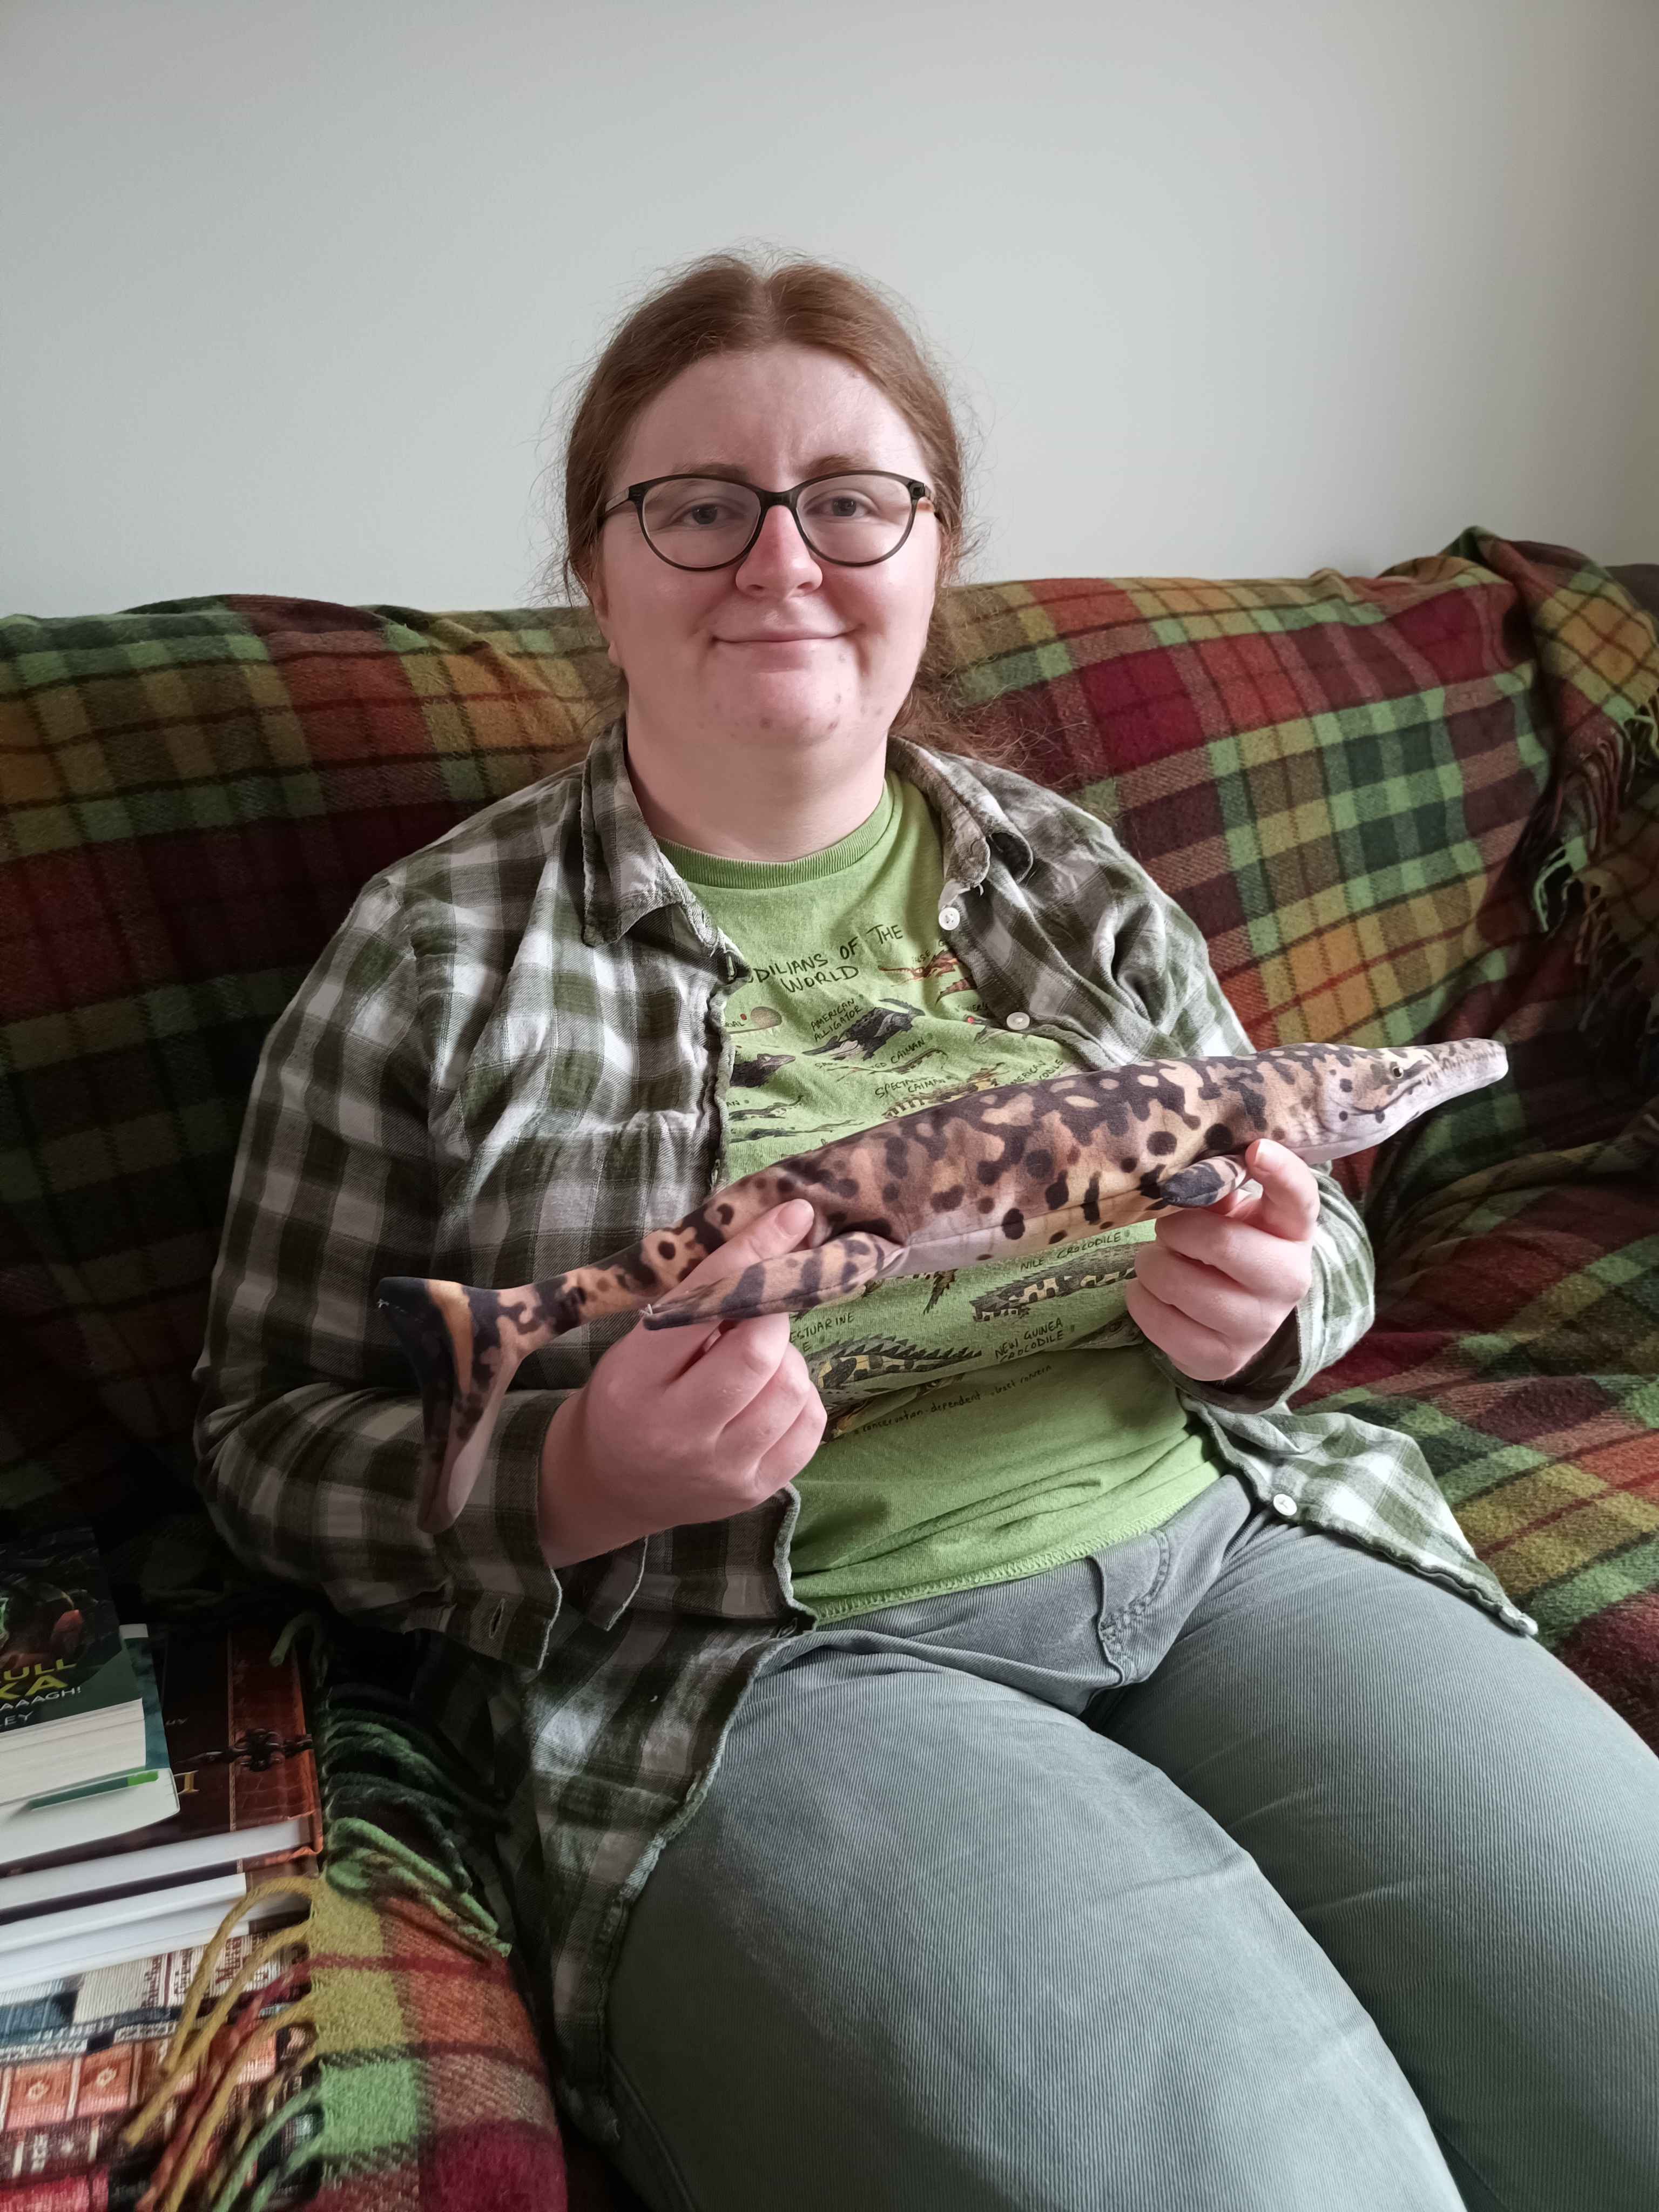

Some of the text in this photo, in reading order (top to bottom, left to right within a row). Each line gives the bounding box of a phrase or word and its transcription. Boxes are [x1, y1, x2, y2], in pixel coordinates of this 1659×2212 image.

[747, 924, 903, 983] DILIANS OF THE
[780, 965, 859, 993] WORLD
[811, 998, 855, 1032] AMERICAN
[813, 1005, 864, 1043] ALLIGATOR
[891, 1036, 926, 1064] CAIMAN
[908, 1078, 947, 1093] CAIMAN
[1008, 1060, 1047, 1084] MERICAN
[1020, 1231, 1122, 1271] NILE CROCODILE
[789, 1312, 855, 1343] ESTUARINE
[994, 1317, 1063, 1360] NEW GUINEA
